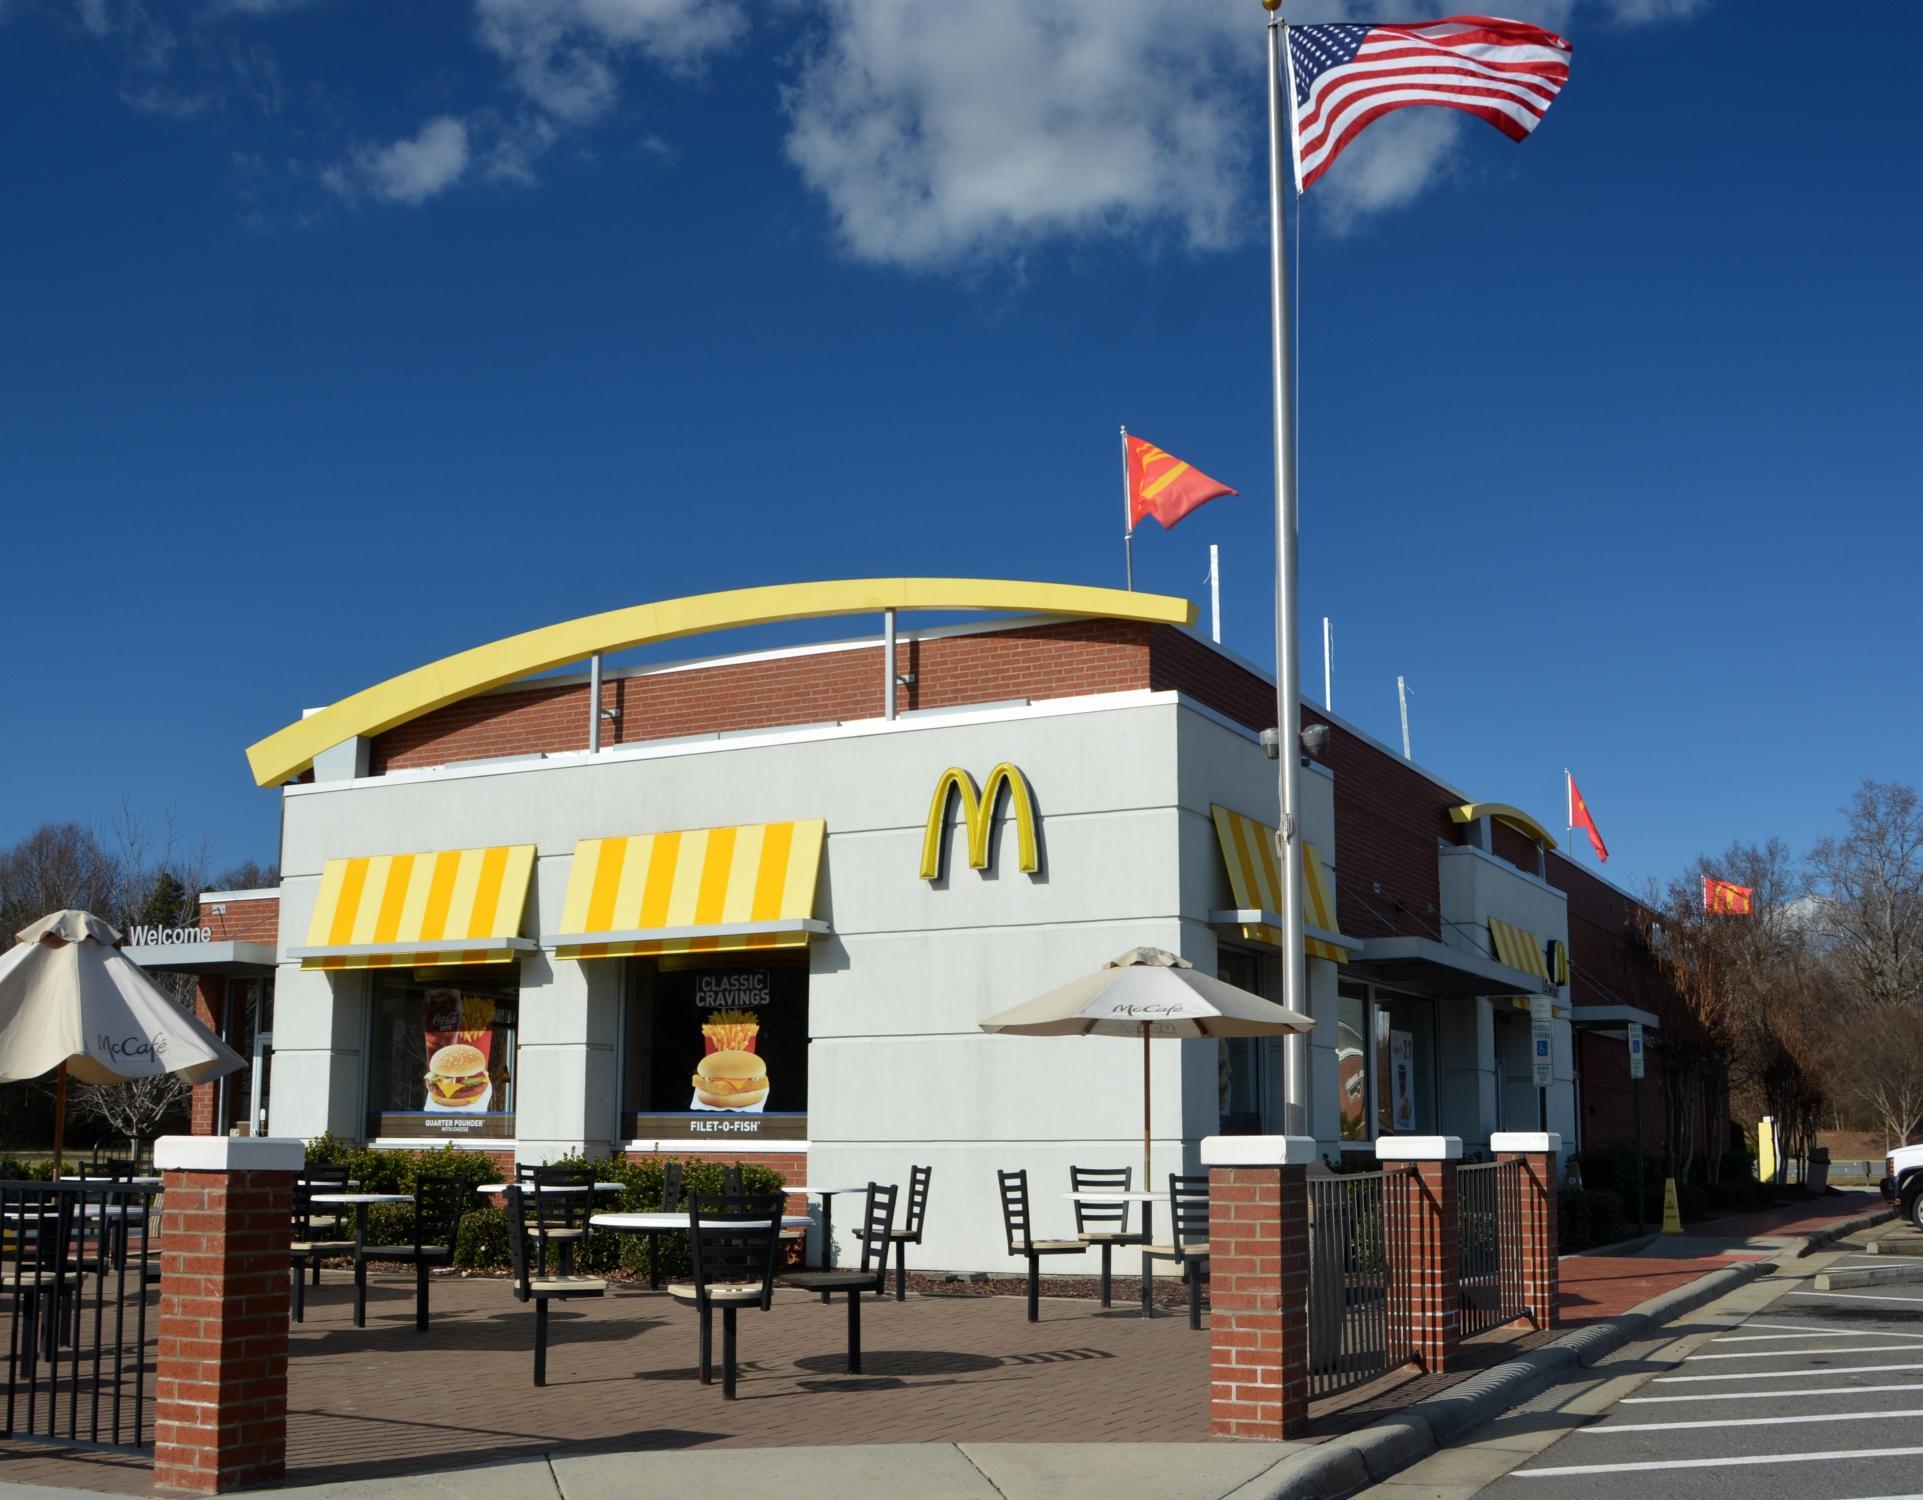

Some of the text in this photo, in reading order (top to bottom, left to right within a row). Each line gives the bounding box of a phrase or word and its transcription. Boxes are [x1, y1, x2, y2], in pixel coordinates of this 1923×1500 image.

[129, 924, 212, 946] Welcome
[701, 974, 764, 992] CLASSIC
[696, 989, 770, 1007] CRAVINGS
[97, 1032, 168, 1063] McCafé
[425, 1119, 453, 1127] QUARTER
[690, 1120, 758, 1132] FILET-O-FISH
